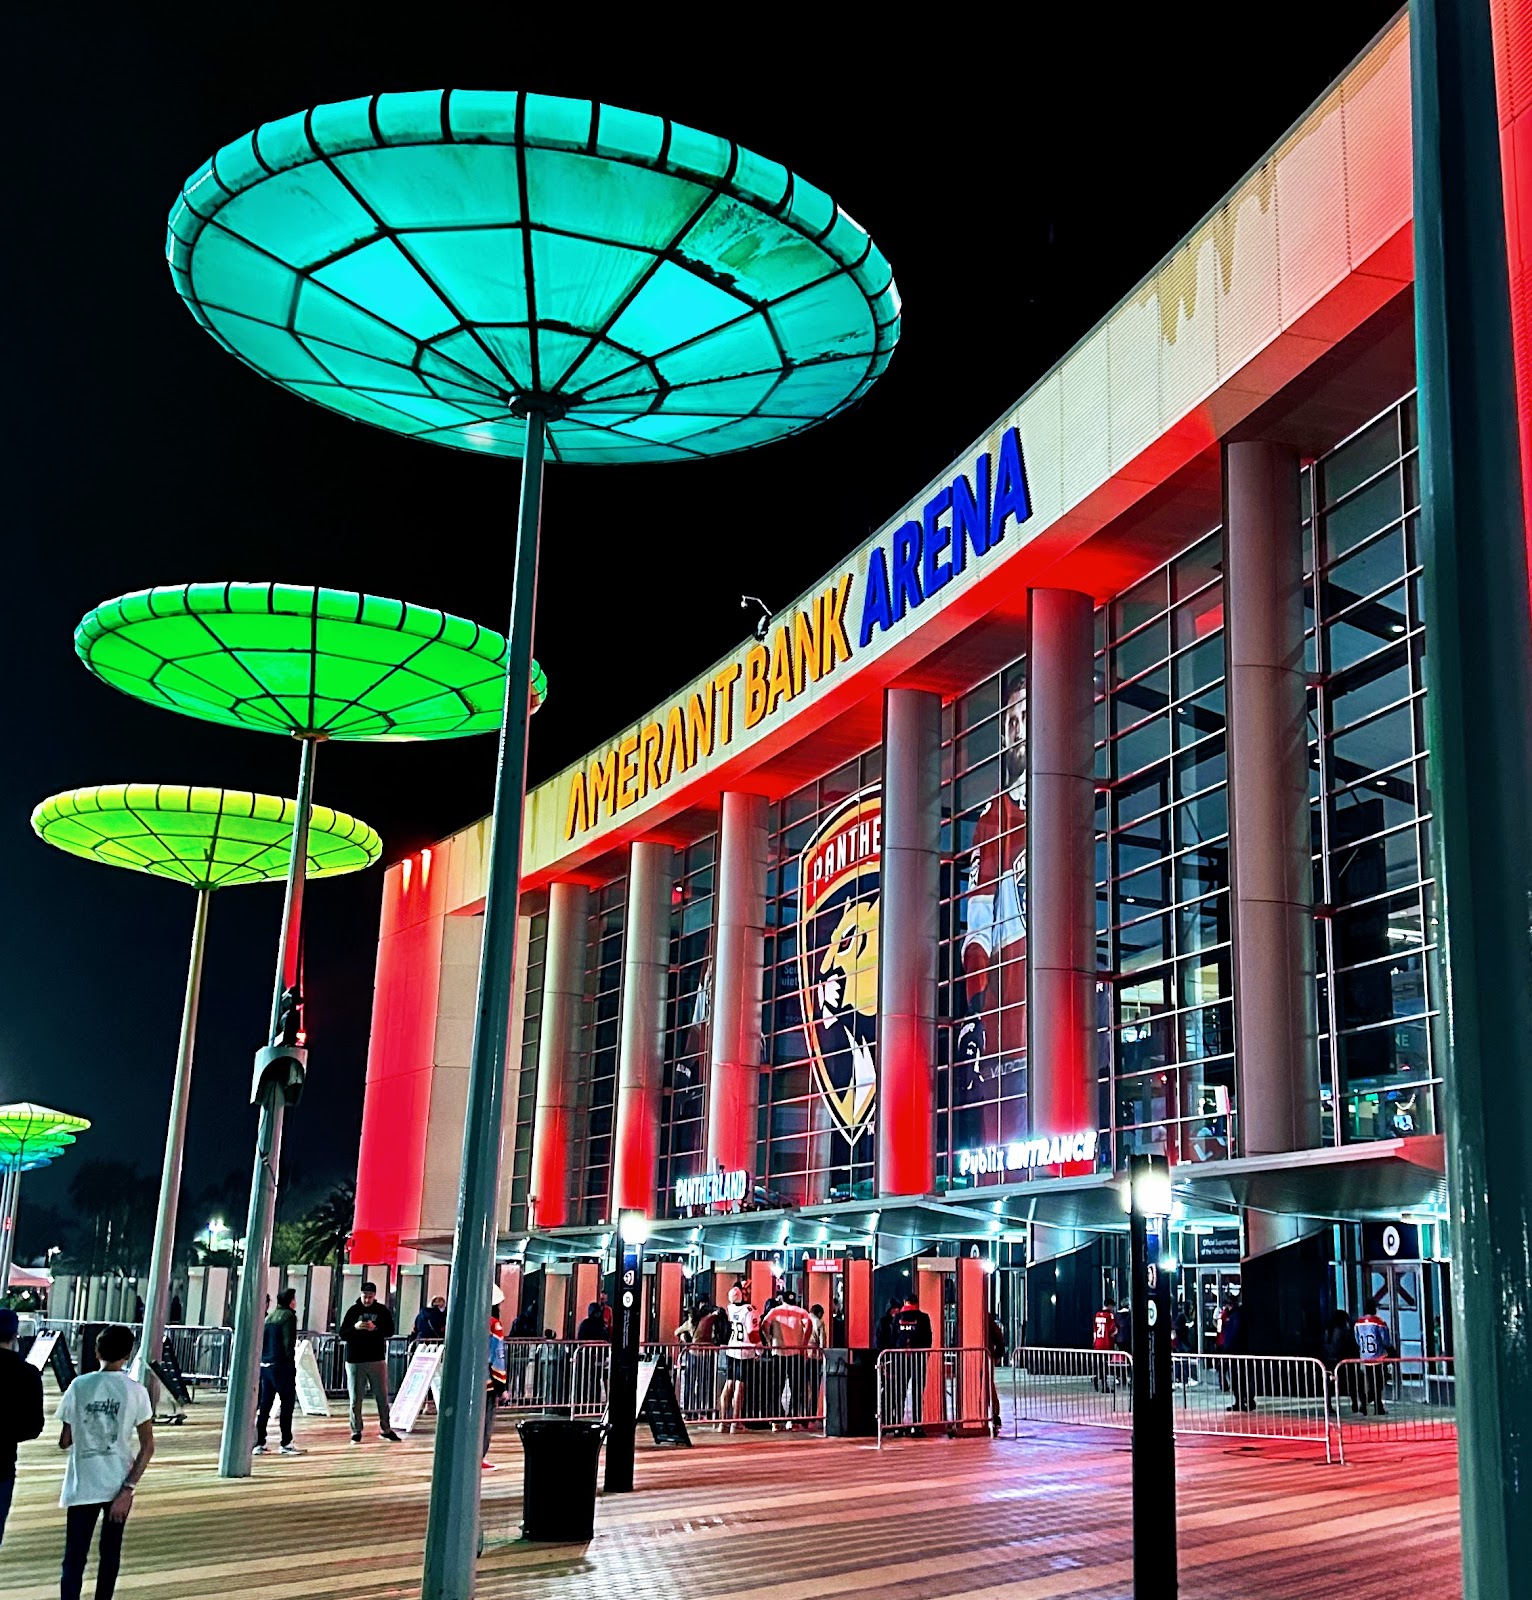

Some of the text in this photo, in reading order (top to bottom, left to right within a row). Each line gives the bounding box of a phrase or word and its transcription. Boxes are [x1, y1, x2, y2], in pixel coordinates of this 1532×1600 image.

[565, 426, 1033, 841] AMERANT BANK ARENA
[959, 1131, 1098, 1175] Publix ENTRANCE
[675, 1169, 748, 1208] PANTHERLAND
[1360, 1334, 1377, 1353] 16
